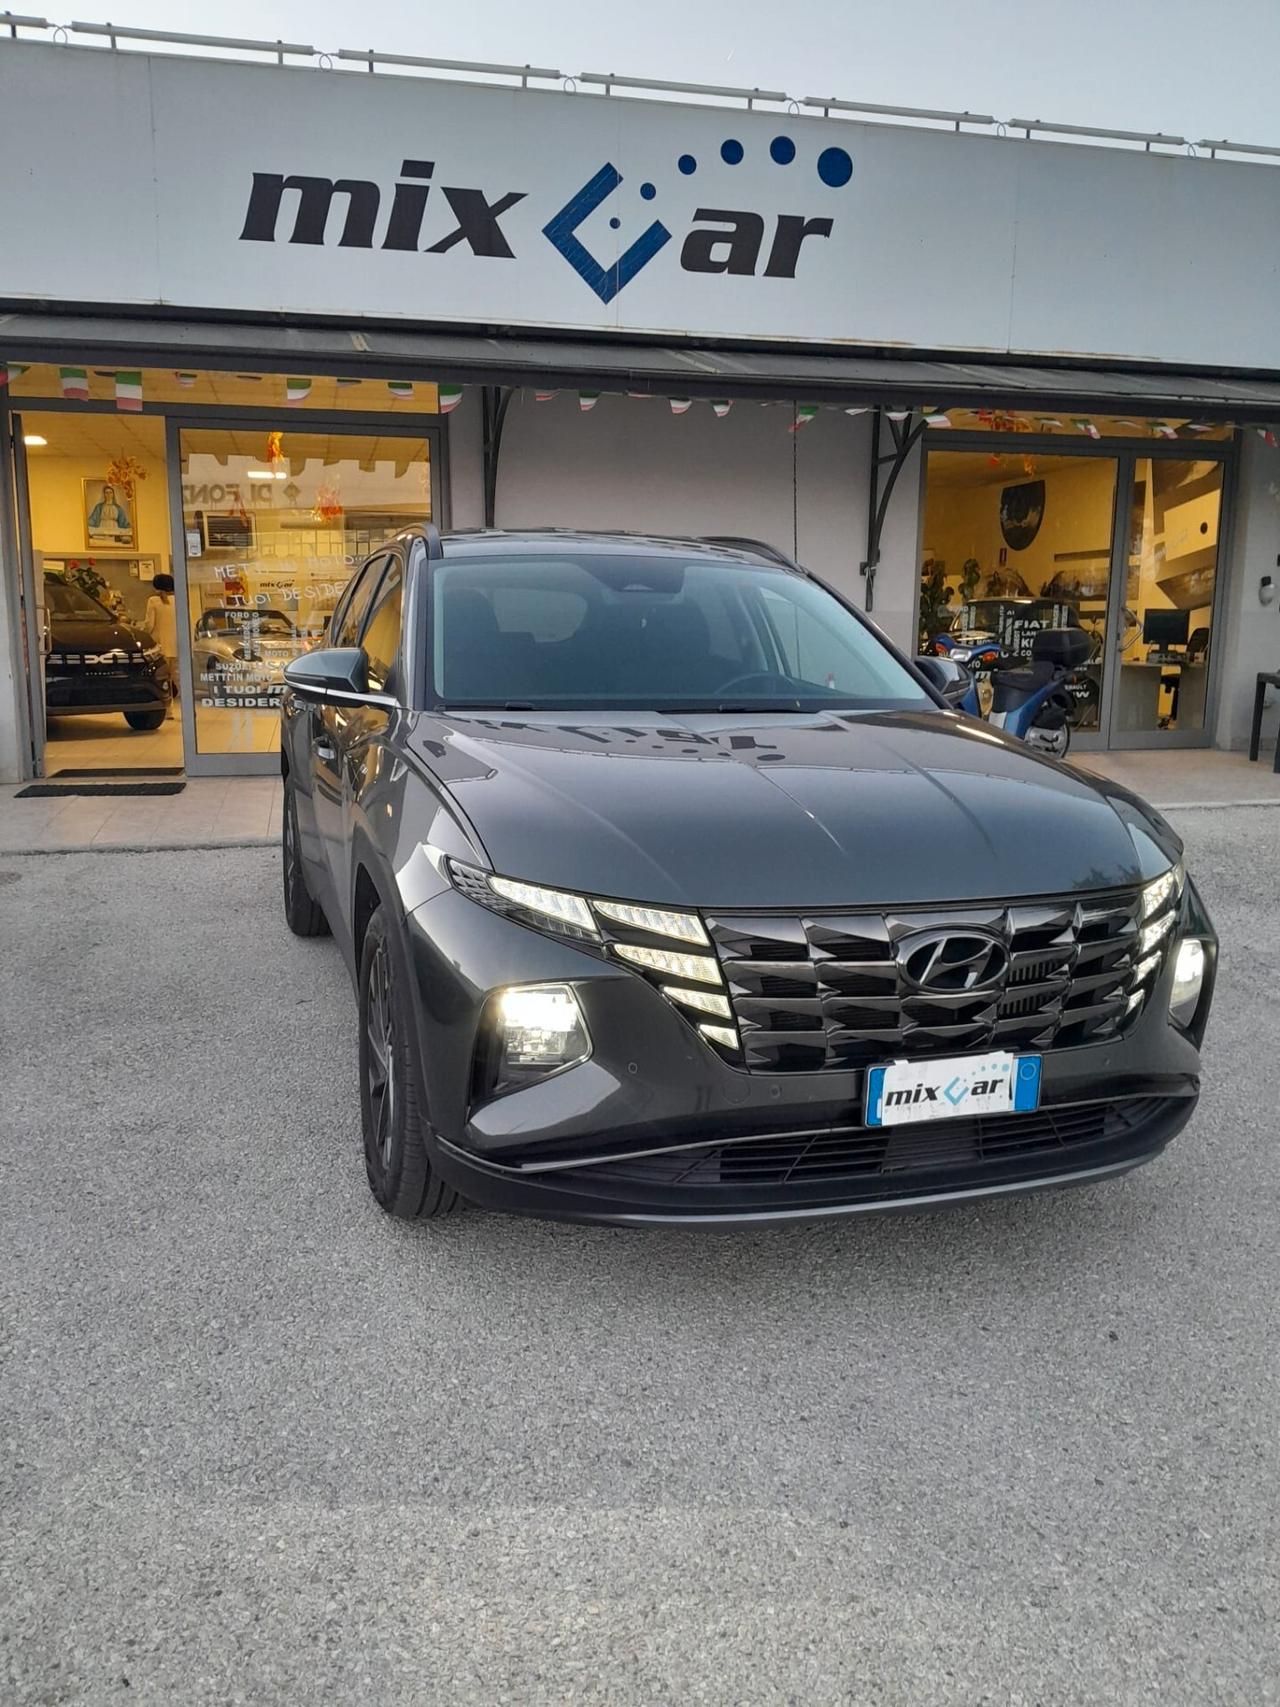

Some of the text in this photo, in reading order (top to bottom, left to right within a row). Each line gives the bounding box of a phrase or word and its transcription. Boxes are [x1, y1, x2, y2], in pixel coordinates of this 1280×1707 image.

[1013, 619, 1050, 629] FIAT
[246, 673, 273, 682] MOTO
[223, 685, 261, 694] TUOI
